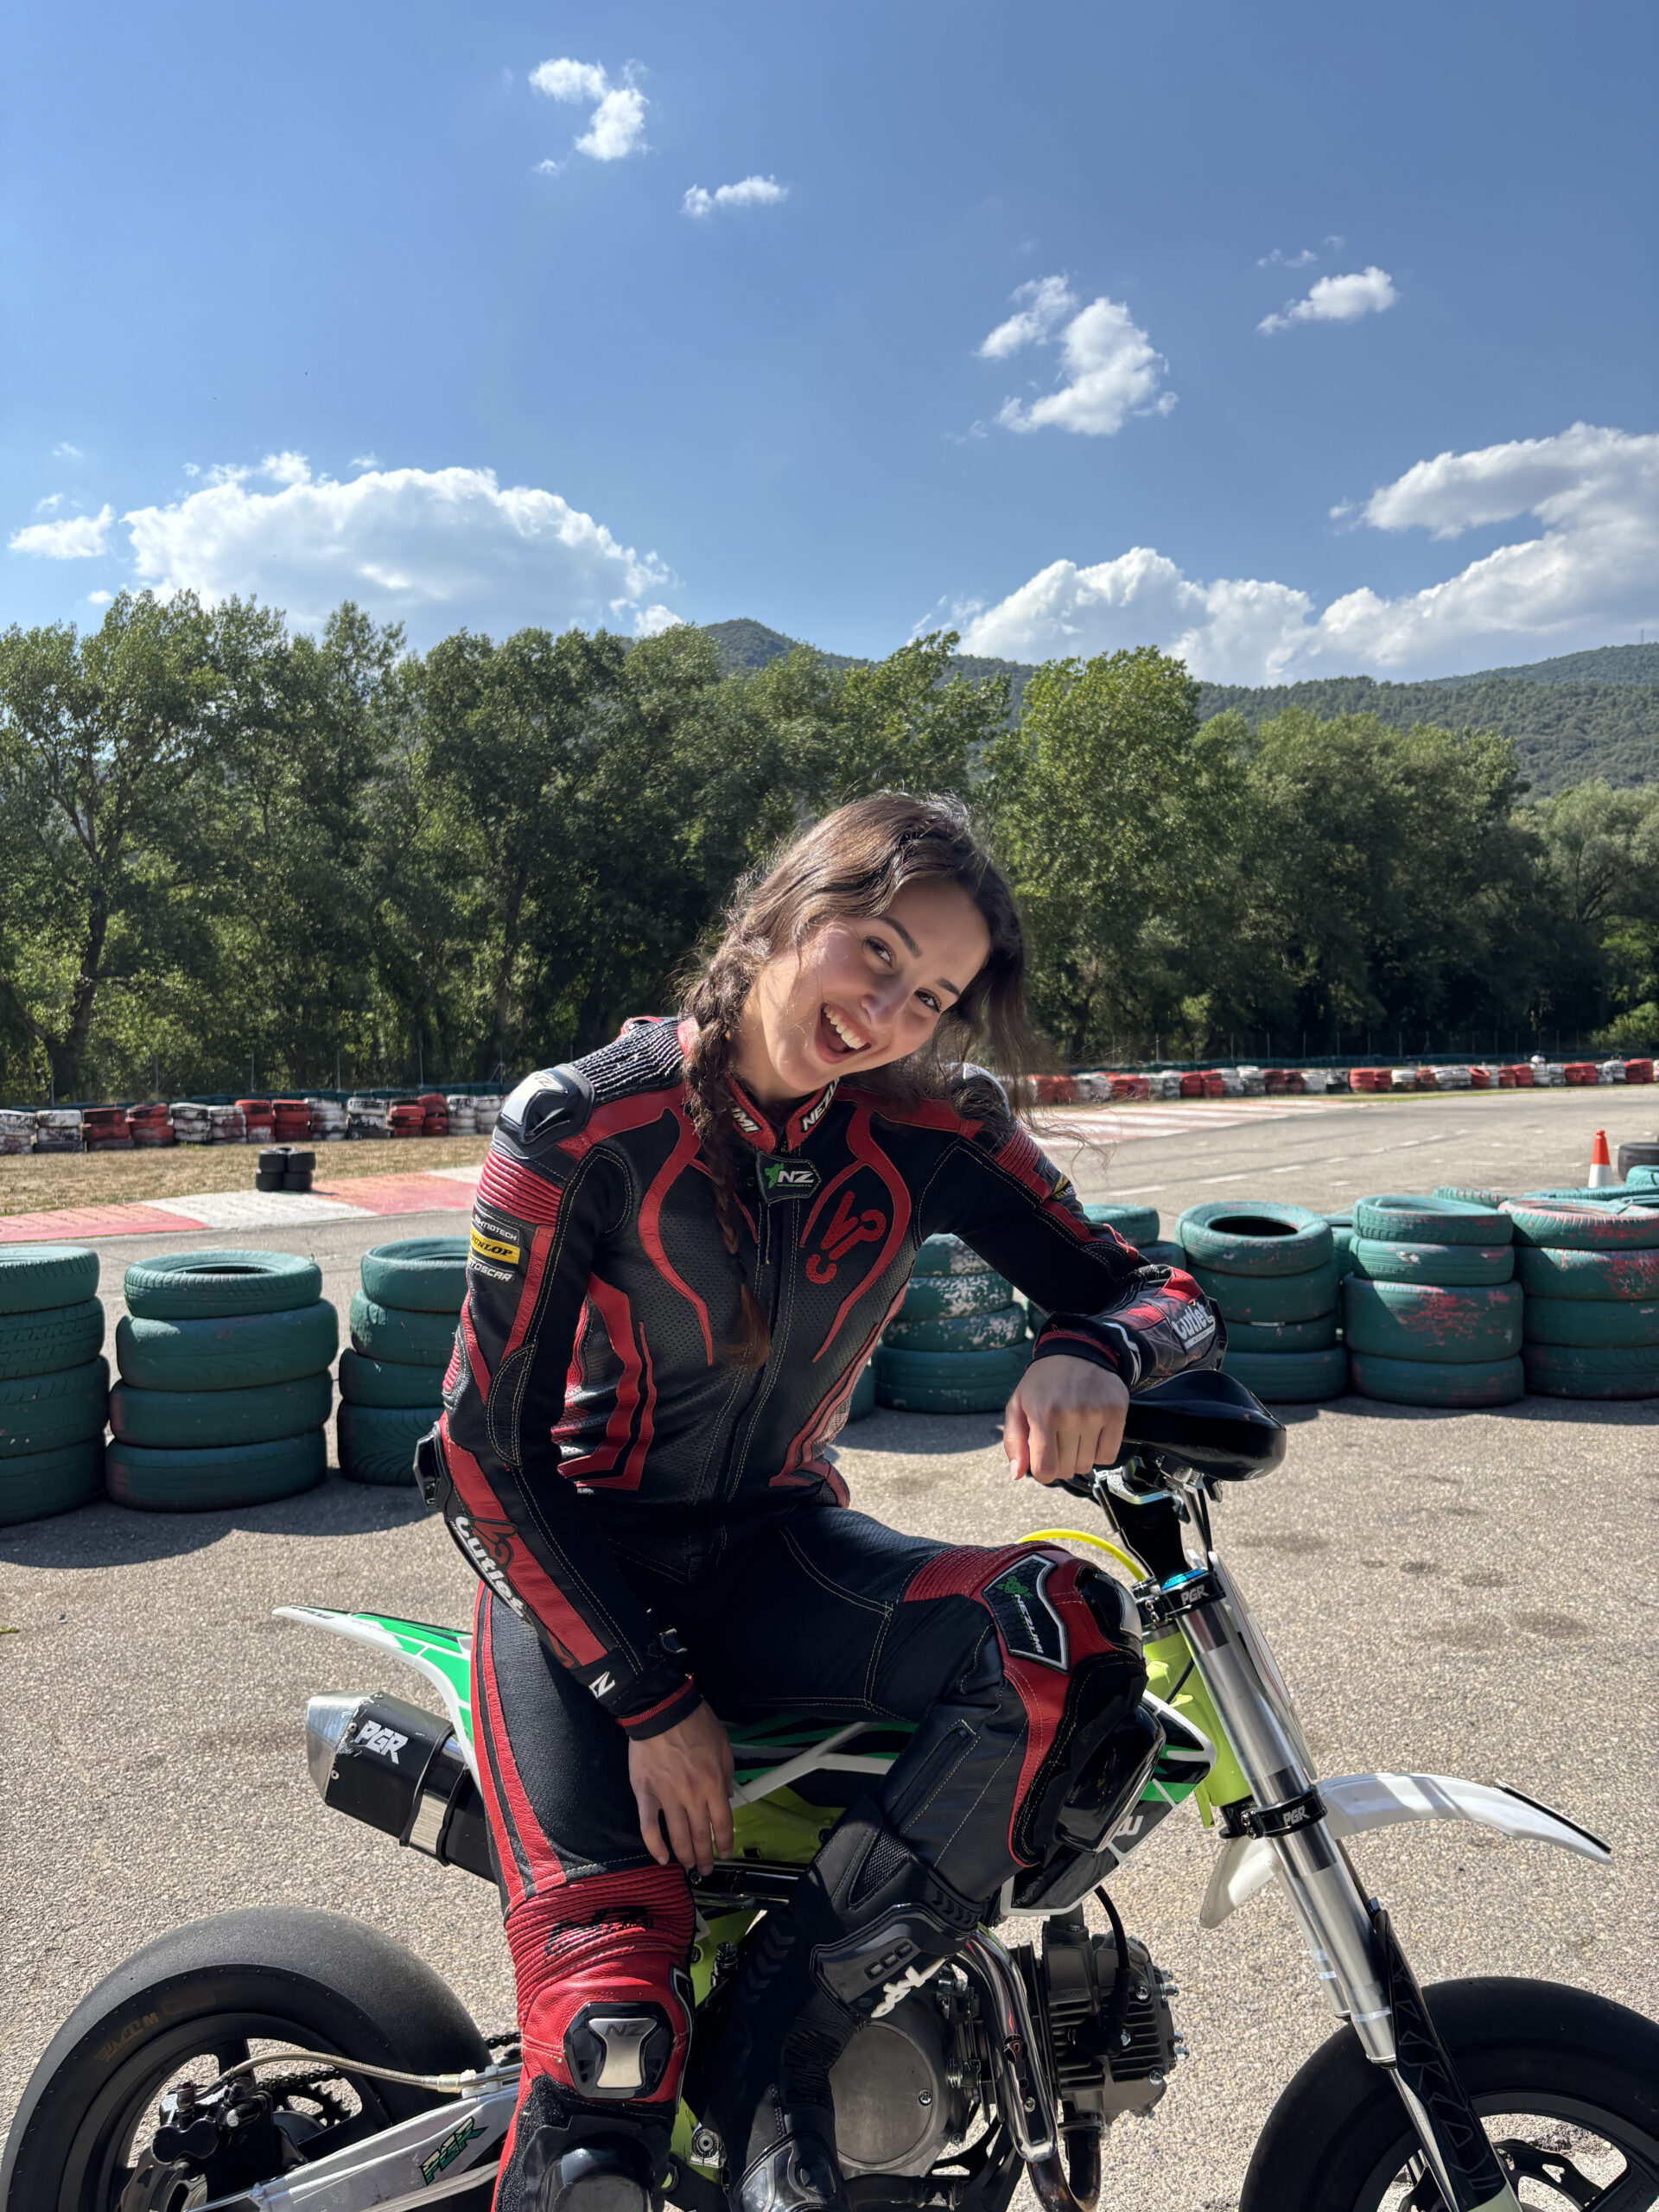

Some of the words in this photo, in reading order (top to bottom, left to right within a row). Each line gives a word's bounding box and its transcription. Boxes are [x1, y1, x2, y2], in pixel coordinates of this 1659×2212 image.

[778, 1170, 815, 1184] NZ
[467, 1257, 513, 1282] TOSCAR
[1180, 1584, 1210, 1606] PGR
[353, 1719, 409, 1764] PGR
[1282, 1805, 1312, 1827] PGR
[607, 2024, 646, 2037] NZ
[418, 2115, 490, 2187] PGR
